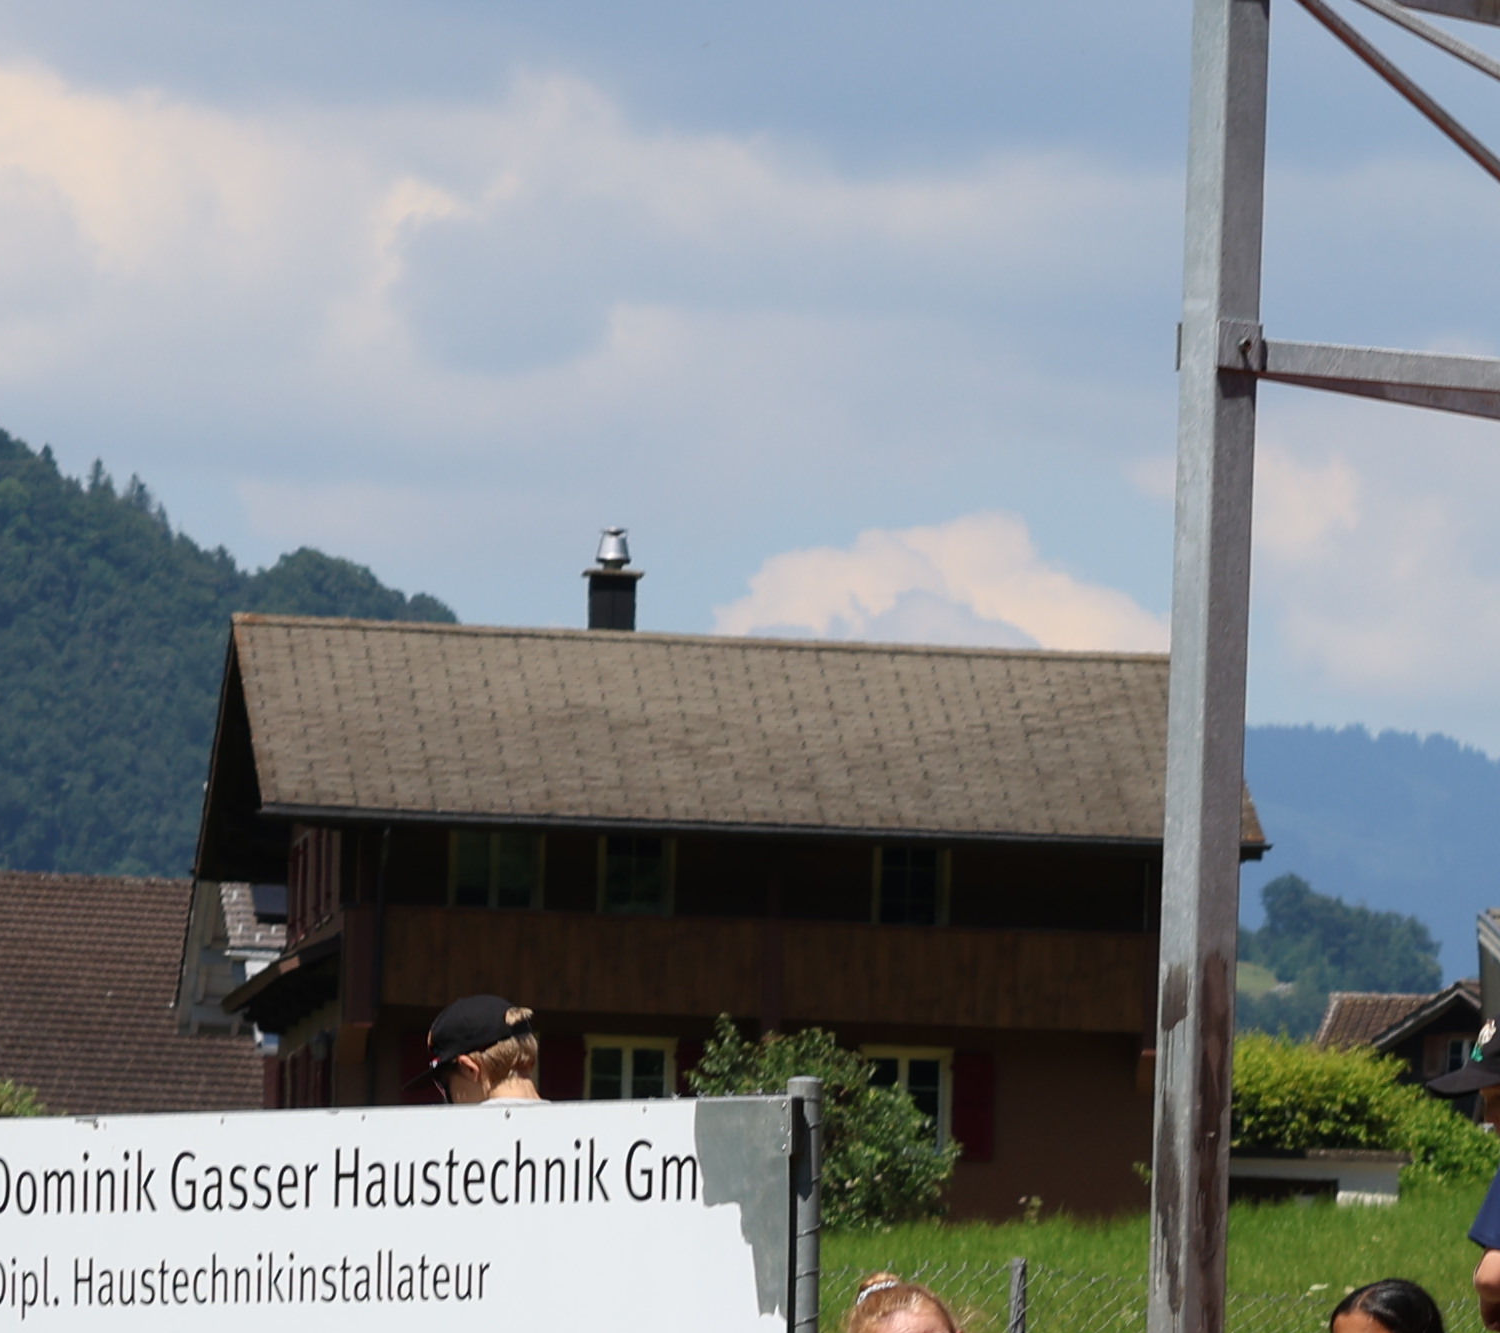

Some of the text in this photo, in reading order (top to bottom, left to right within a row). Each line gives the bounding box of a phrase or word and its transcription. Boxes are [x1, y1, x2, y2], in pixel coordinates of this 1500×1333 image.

[170, 1150, 319, 1212] Gasser
[333, 1138, 611, 1208] Haustechnik
[73, 1248, 491, 1308] Haustechnikinstallateur
